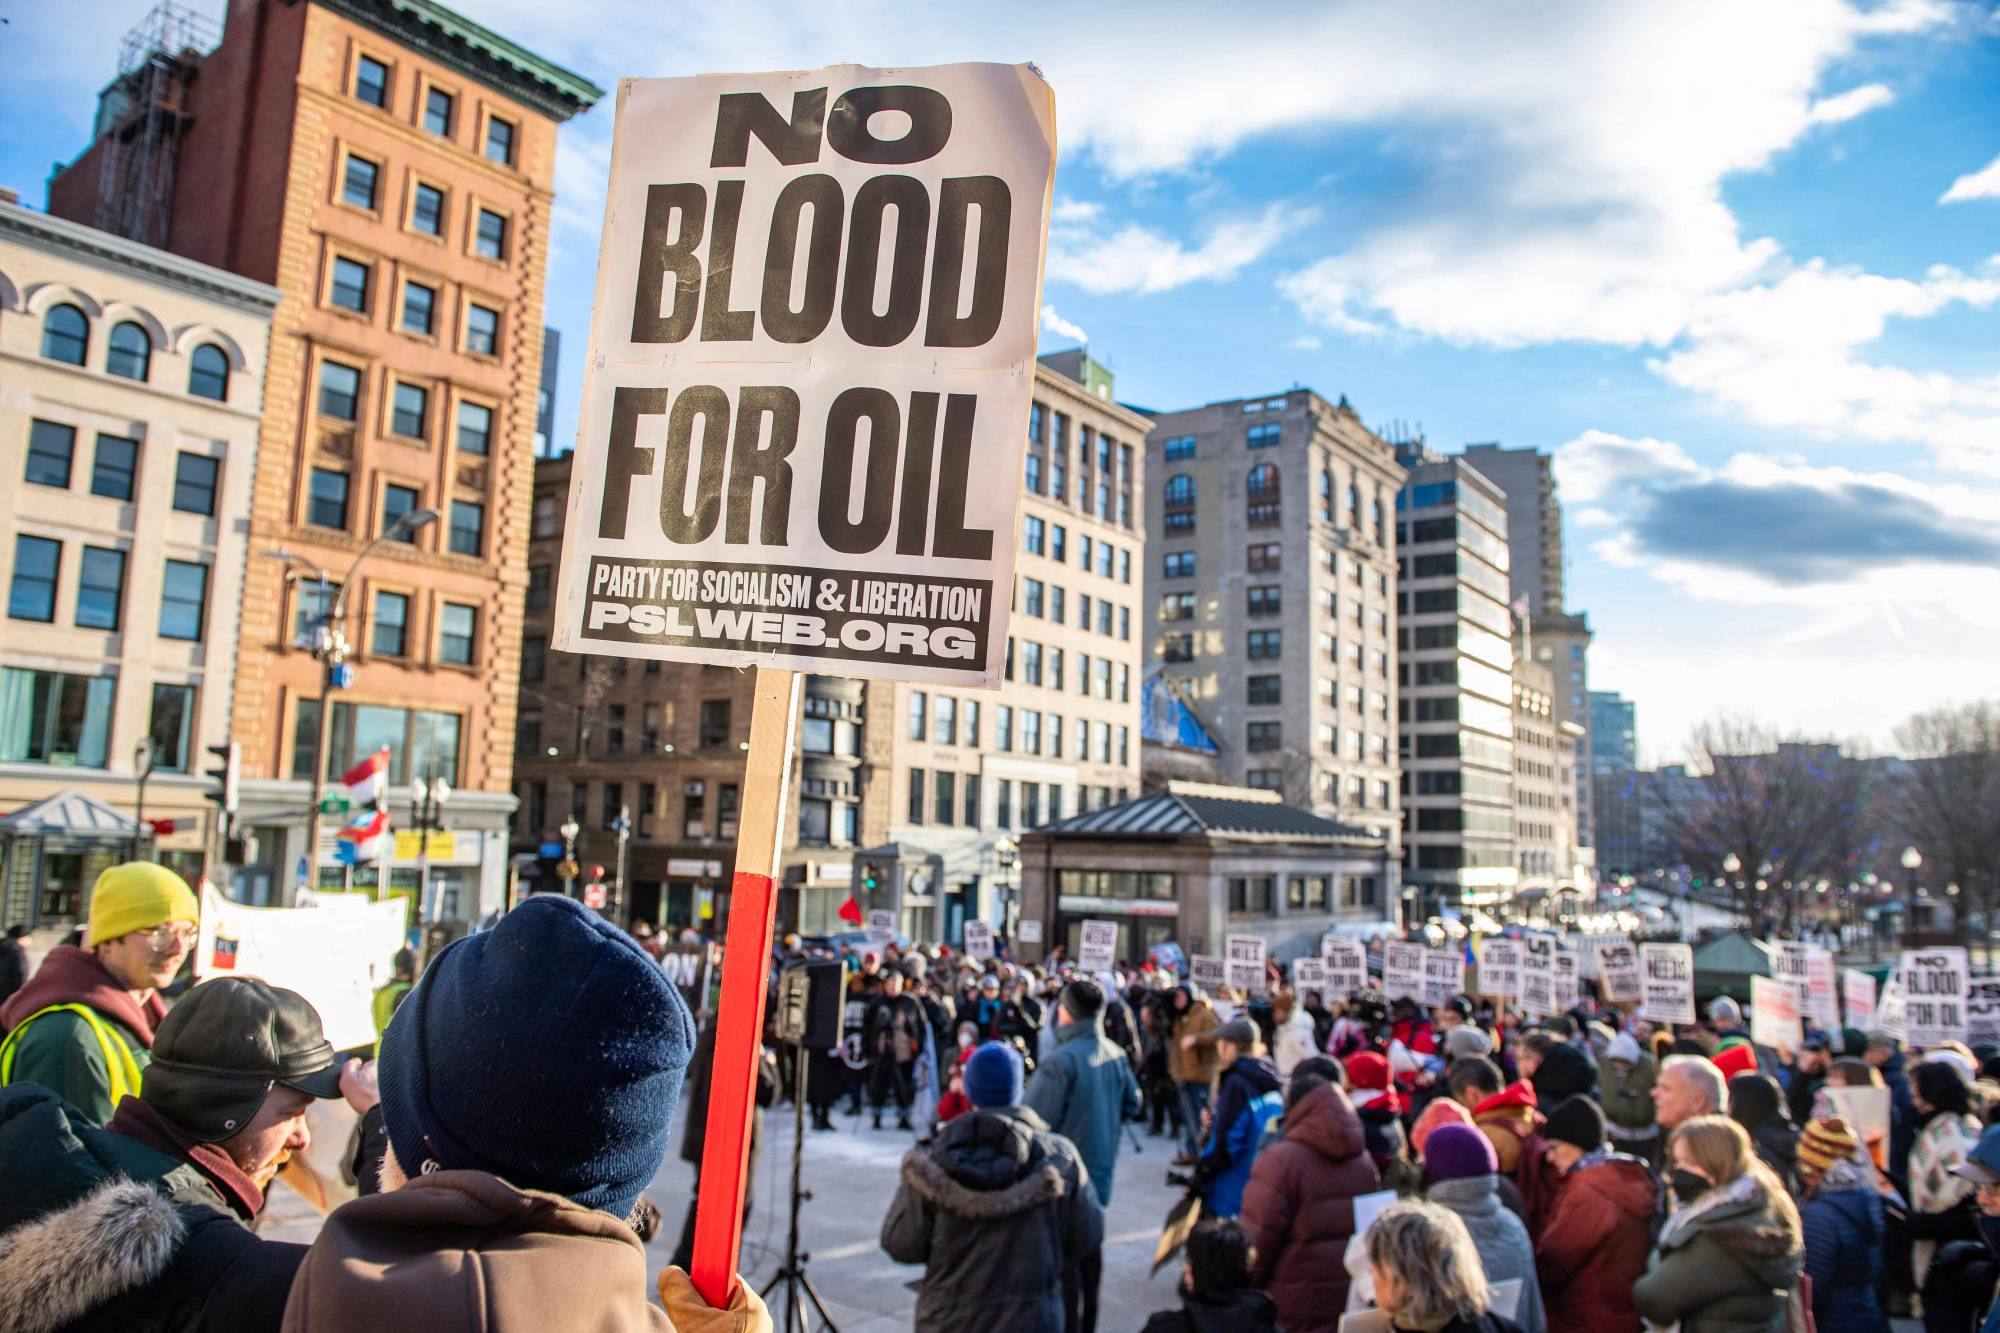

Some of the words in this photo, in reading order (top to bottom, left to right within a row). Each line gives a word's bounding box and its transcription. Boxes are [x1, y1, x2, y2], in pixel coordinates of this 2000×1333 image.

[710, 85, 952, 168] NO
[631, 174, 1012, 347] BLOOD
[598, 385, 801, 547] FOR
[818, 387, 994, 560] OIL
[593, 564, 661, 599] PARTY
[661, 568, 699, 601] FOR
[701, 570, 812, 608] SOCIALISM
[815, 579, 845, 612] &
[850, 580, 982, 622] LIBERATION
[589, 601, 976, 659] PSLWEB.ORG
[1915, 957, 1948, 967] NO
